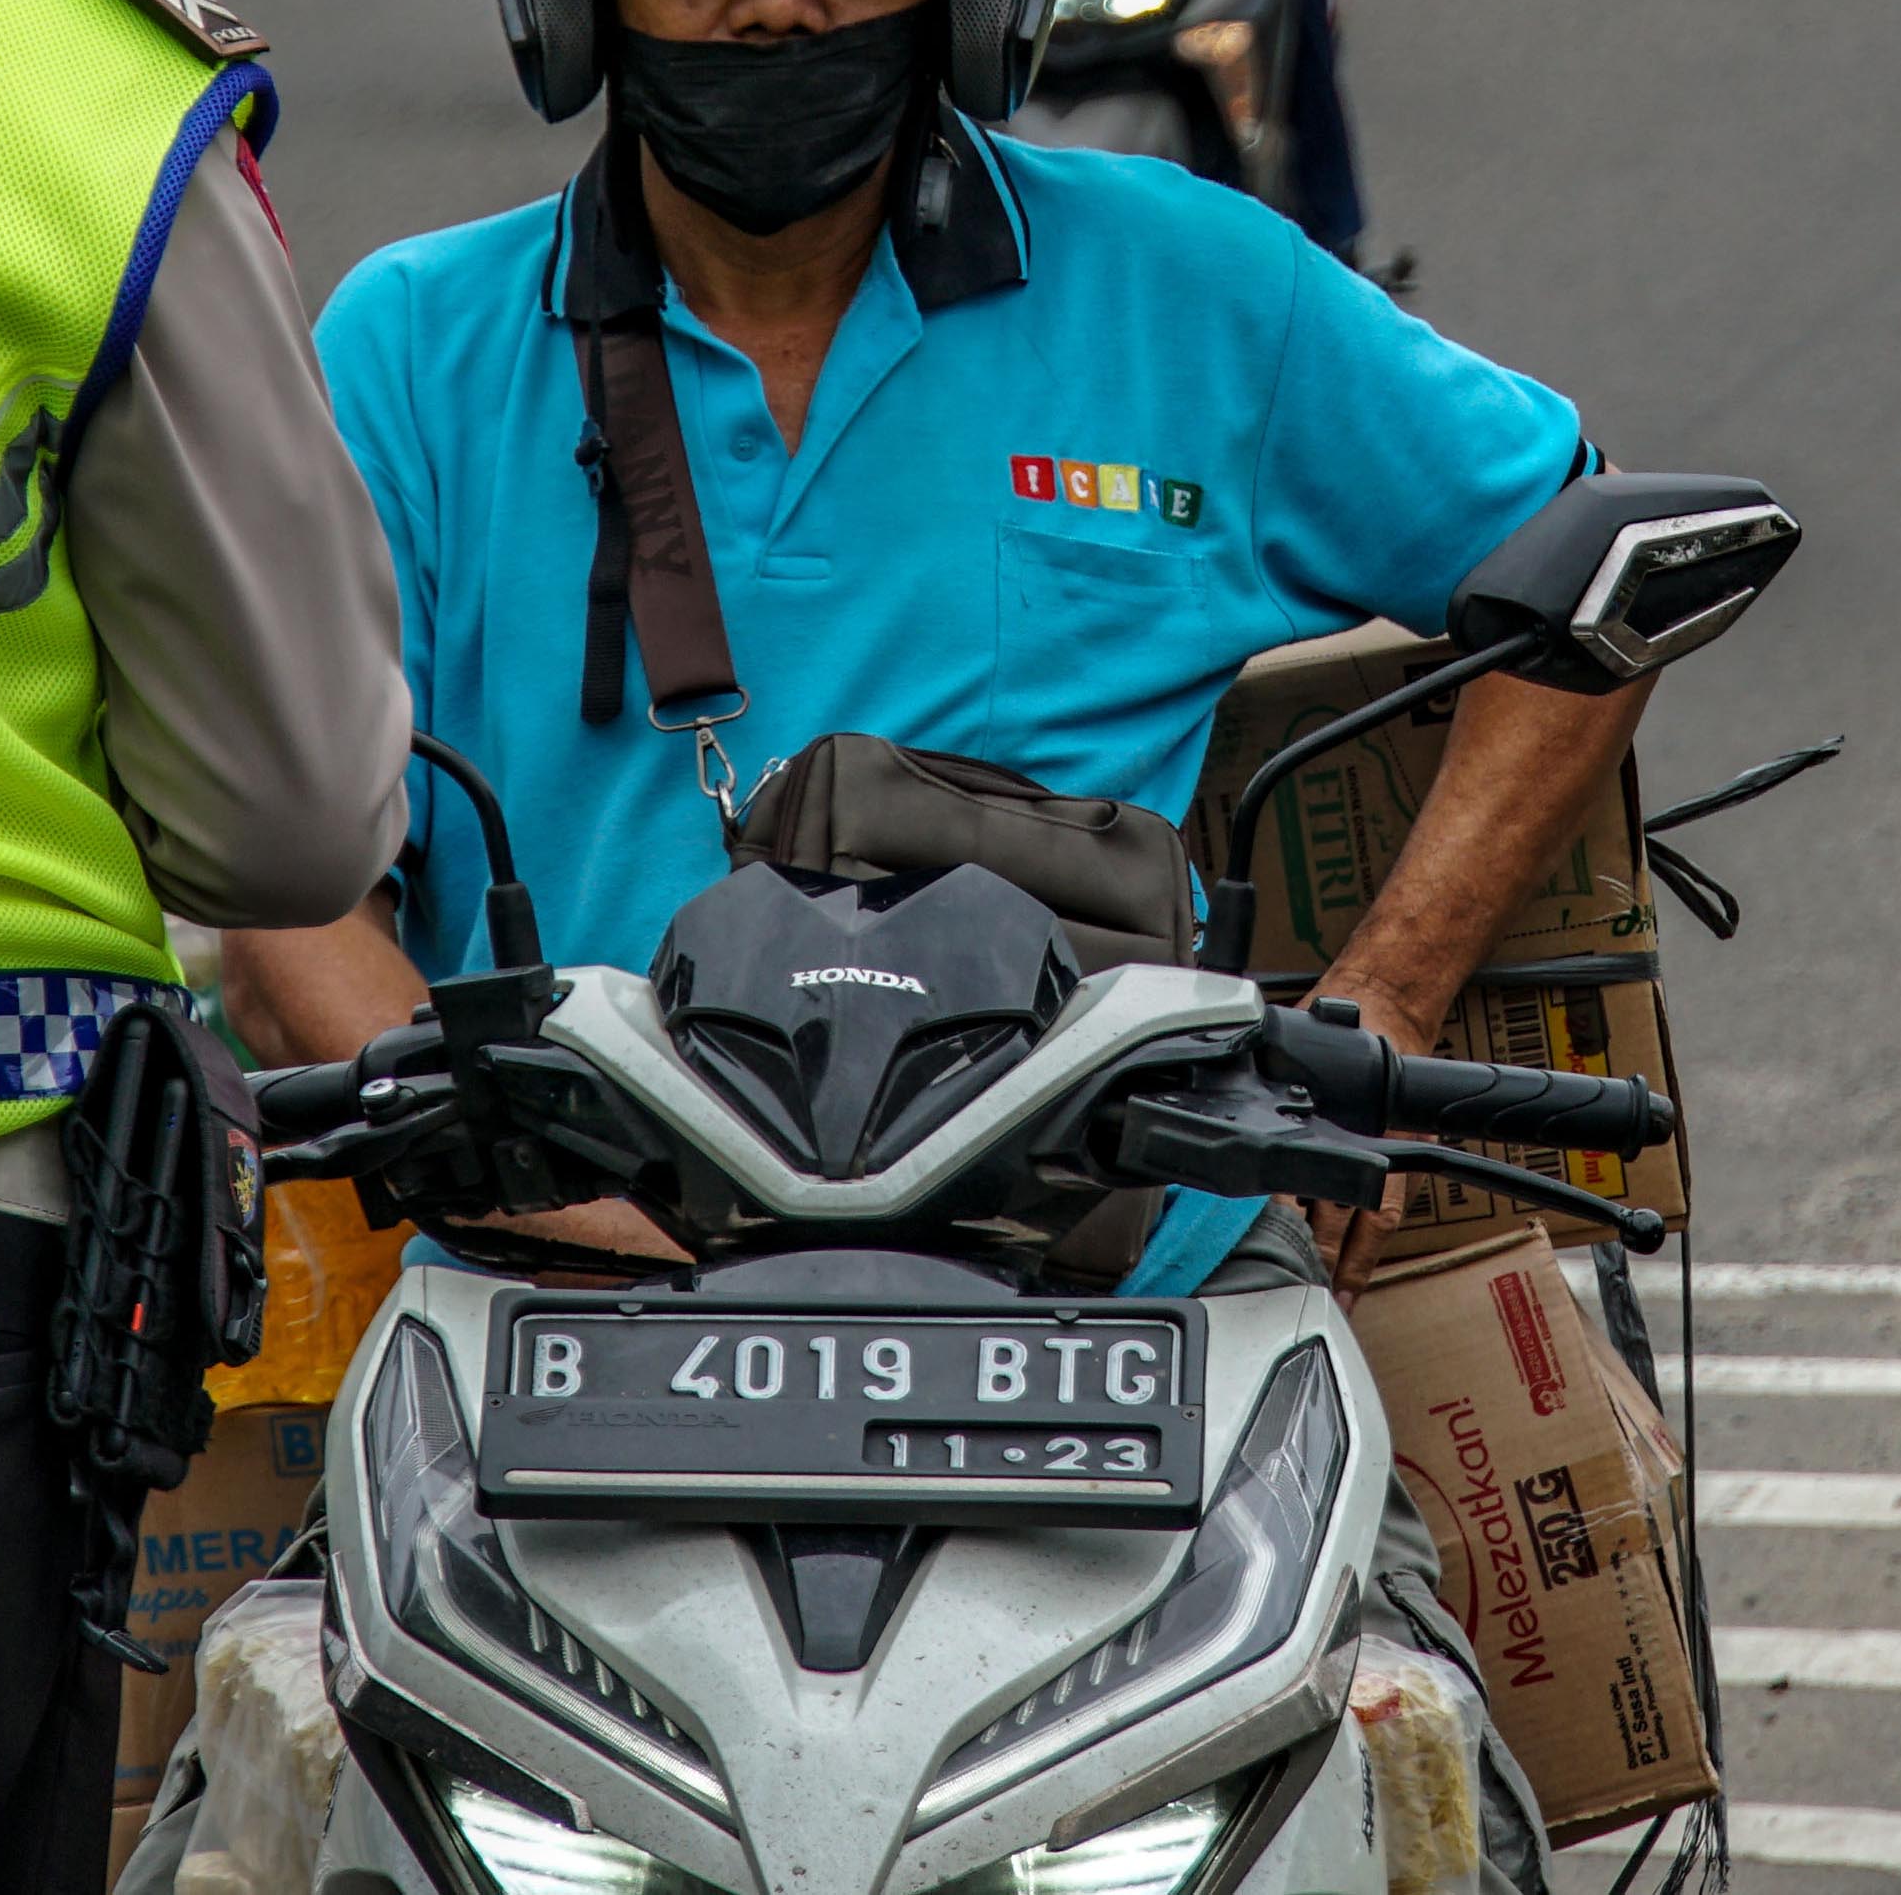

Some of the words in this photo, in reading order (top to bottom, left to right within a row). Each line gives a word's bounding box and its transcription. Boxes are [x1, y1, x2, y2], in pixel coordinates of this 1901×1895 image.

[1302, 766, 1360, 913] FITRI
[789, 966, 927, 996] HONDA
[533, 1334, 582, 1398] B
[670, 1335, 911, 1401] 4019
[976, 1336, 1158, 1406] BTG
[1429, 1396, 1554, 1691] Melezatkan!
[1628, 1690, 1649, 1732] Sasa
[1636, 1736, 1657, 1766] PT.
